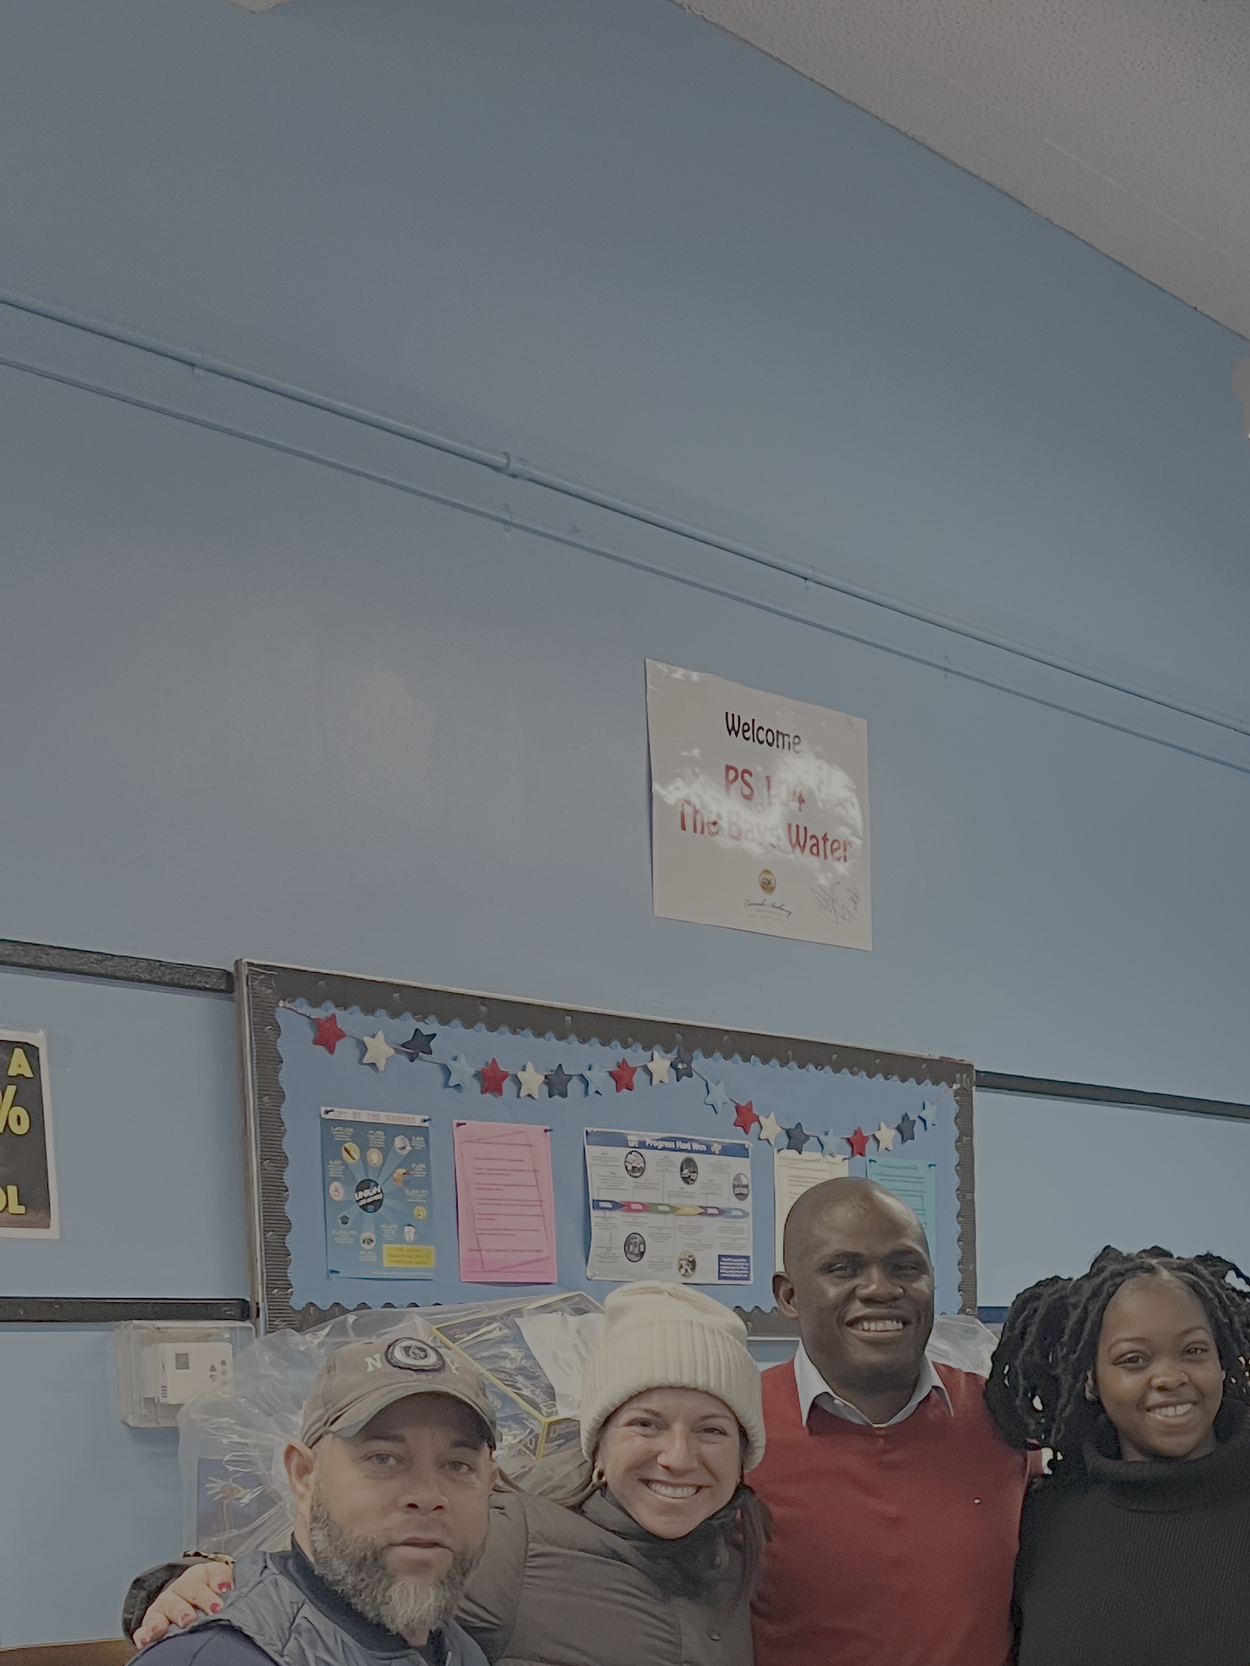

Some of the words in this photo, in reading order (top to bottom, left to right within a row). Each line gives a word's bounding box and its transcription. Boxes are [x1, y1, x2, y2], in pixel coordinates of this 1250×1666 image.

[725, 711, 802, 753] Welcome
[724, 764, 755, 801] PS
[787, 822, 853, 862] Water
[7, 1047, 34, 1079] A
